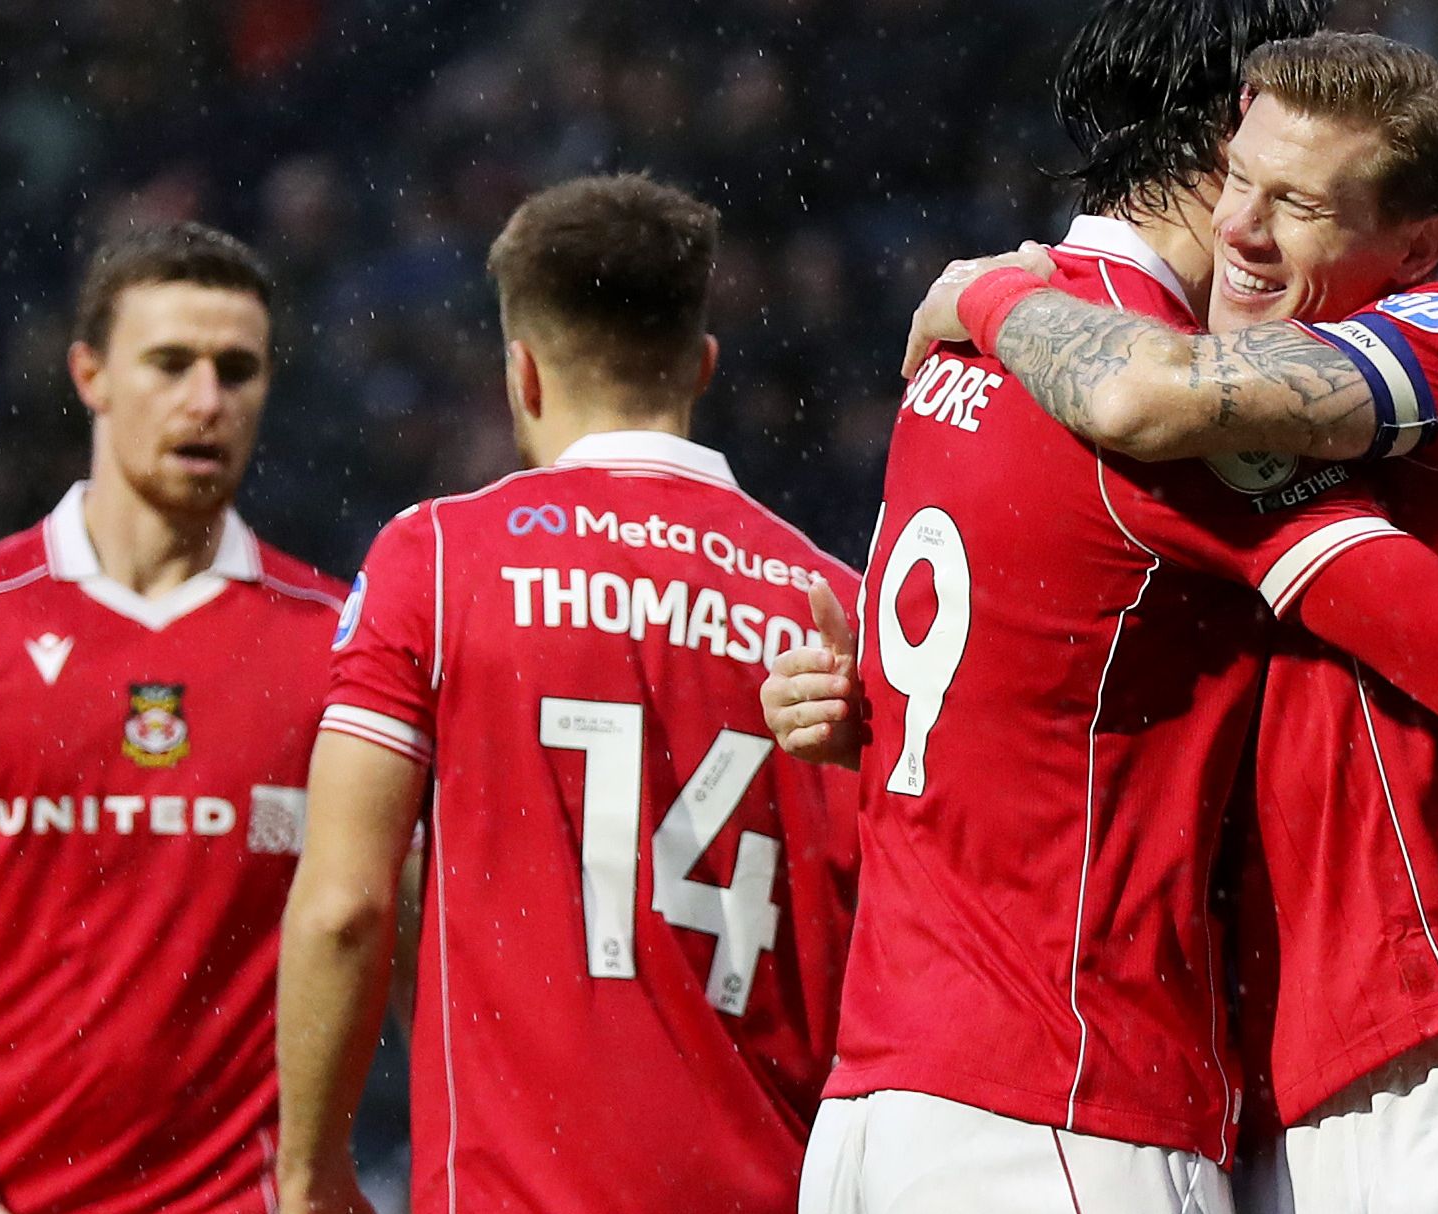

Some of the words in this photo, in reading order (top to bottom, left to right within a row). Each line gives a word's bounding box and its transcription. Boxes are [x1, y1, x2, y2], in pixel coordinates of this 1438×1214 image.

[1340, 323, 1377, 349] TAIN
[1258, 457, 1285, 480] EFL
[574, 505, 696, 554] Meta
[878, 506, 971, 797] 9
[540, 697, 781, 1017] 14
